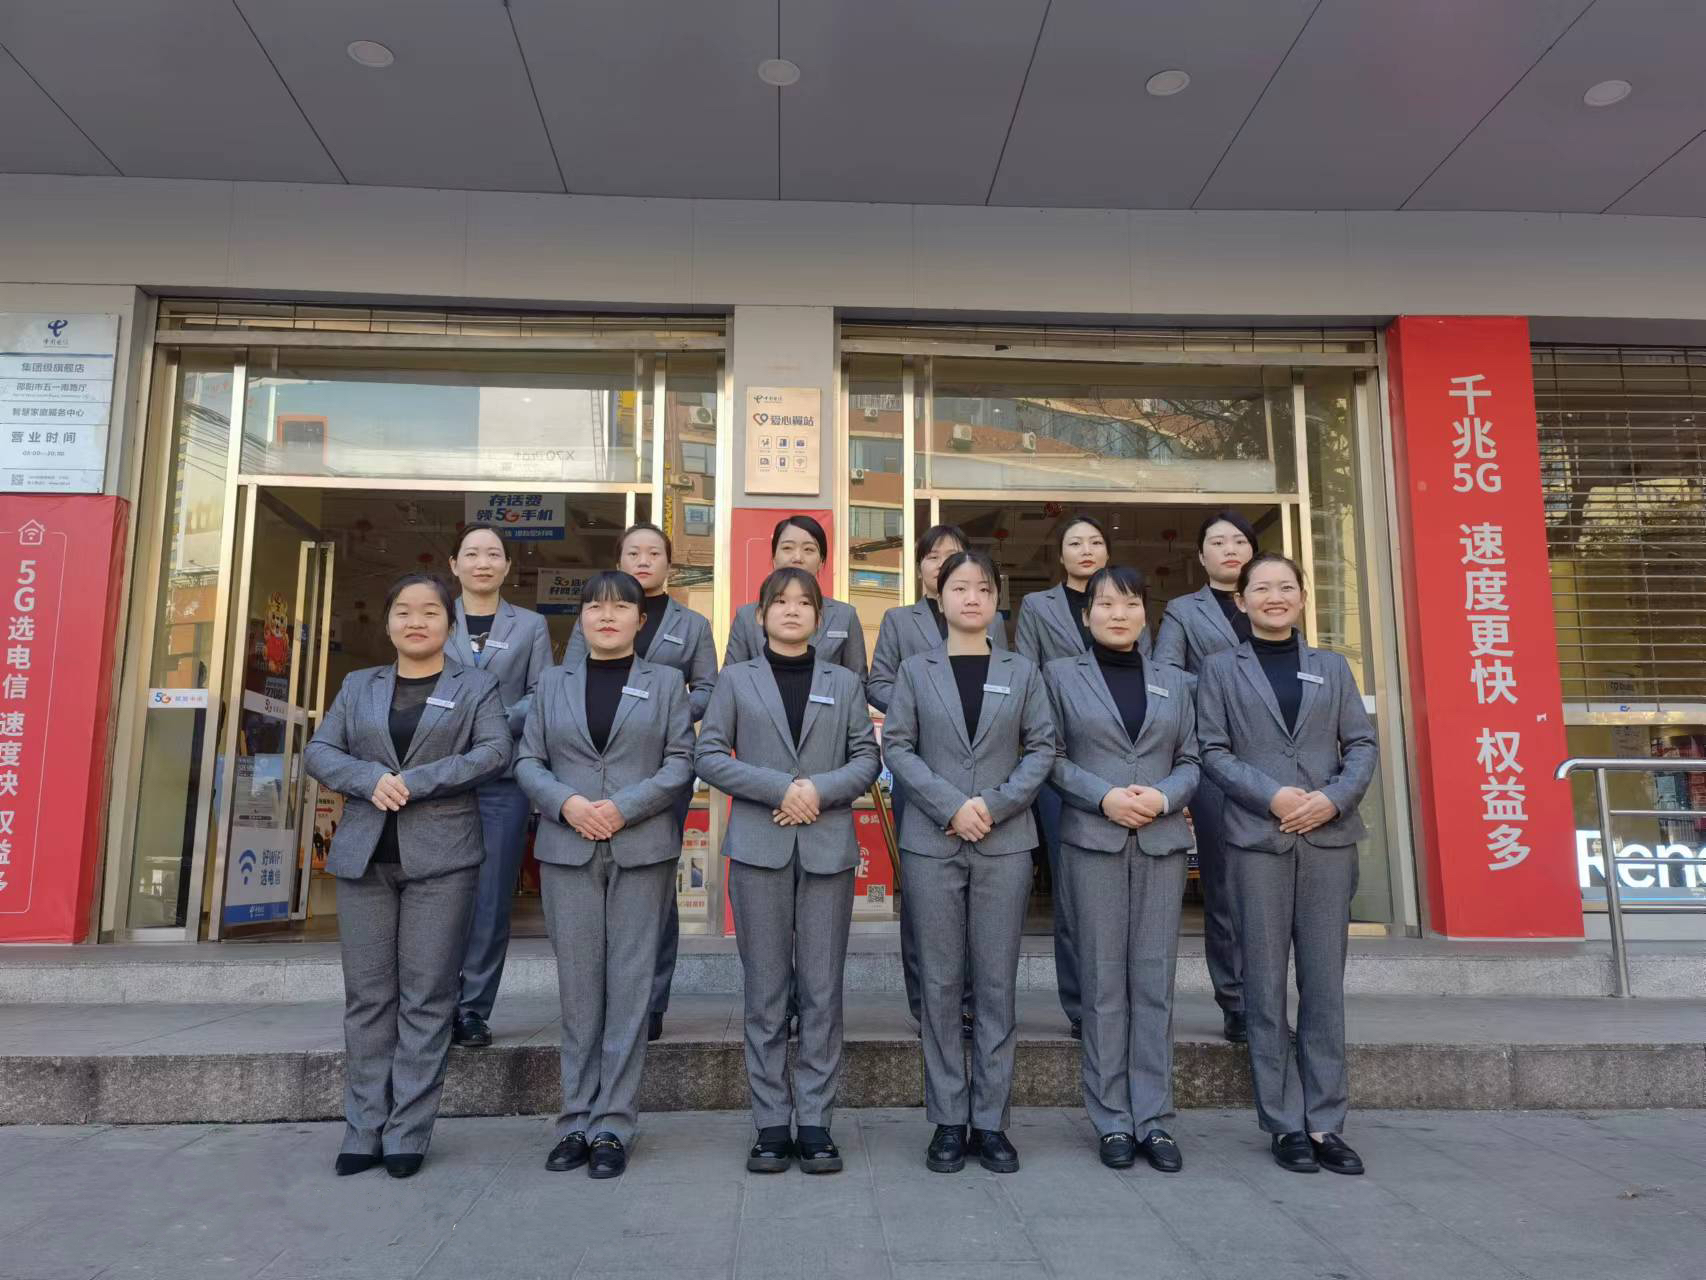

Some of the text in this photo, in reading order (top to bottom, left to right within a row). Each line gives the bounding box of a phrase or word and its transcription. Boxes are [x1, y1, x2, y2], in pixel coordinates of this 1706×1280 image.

[22, 363, 85, 373] 集团级旗舰店
[11, 432, 77, 444] 营业时间
[489, 494, 543, 506] 存话费
[1449, 374, 1531, 871] 千兆5G 速度更快 权益多
[3, 560, 36, 699] 5G选电信
